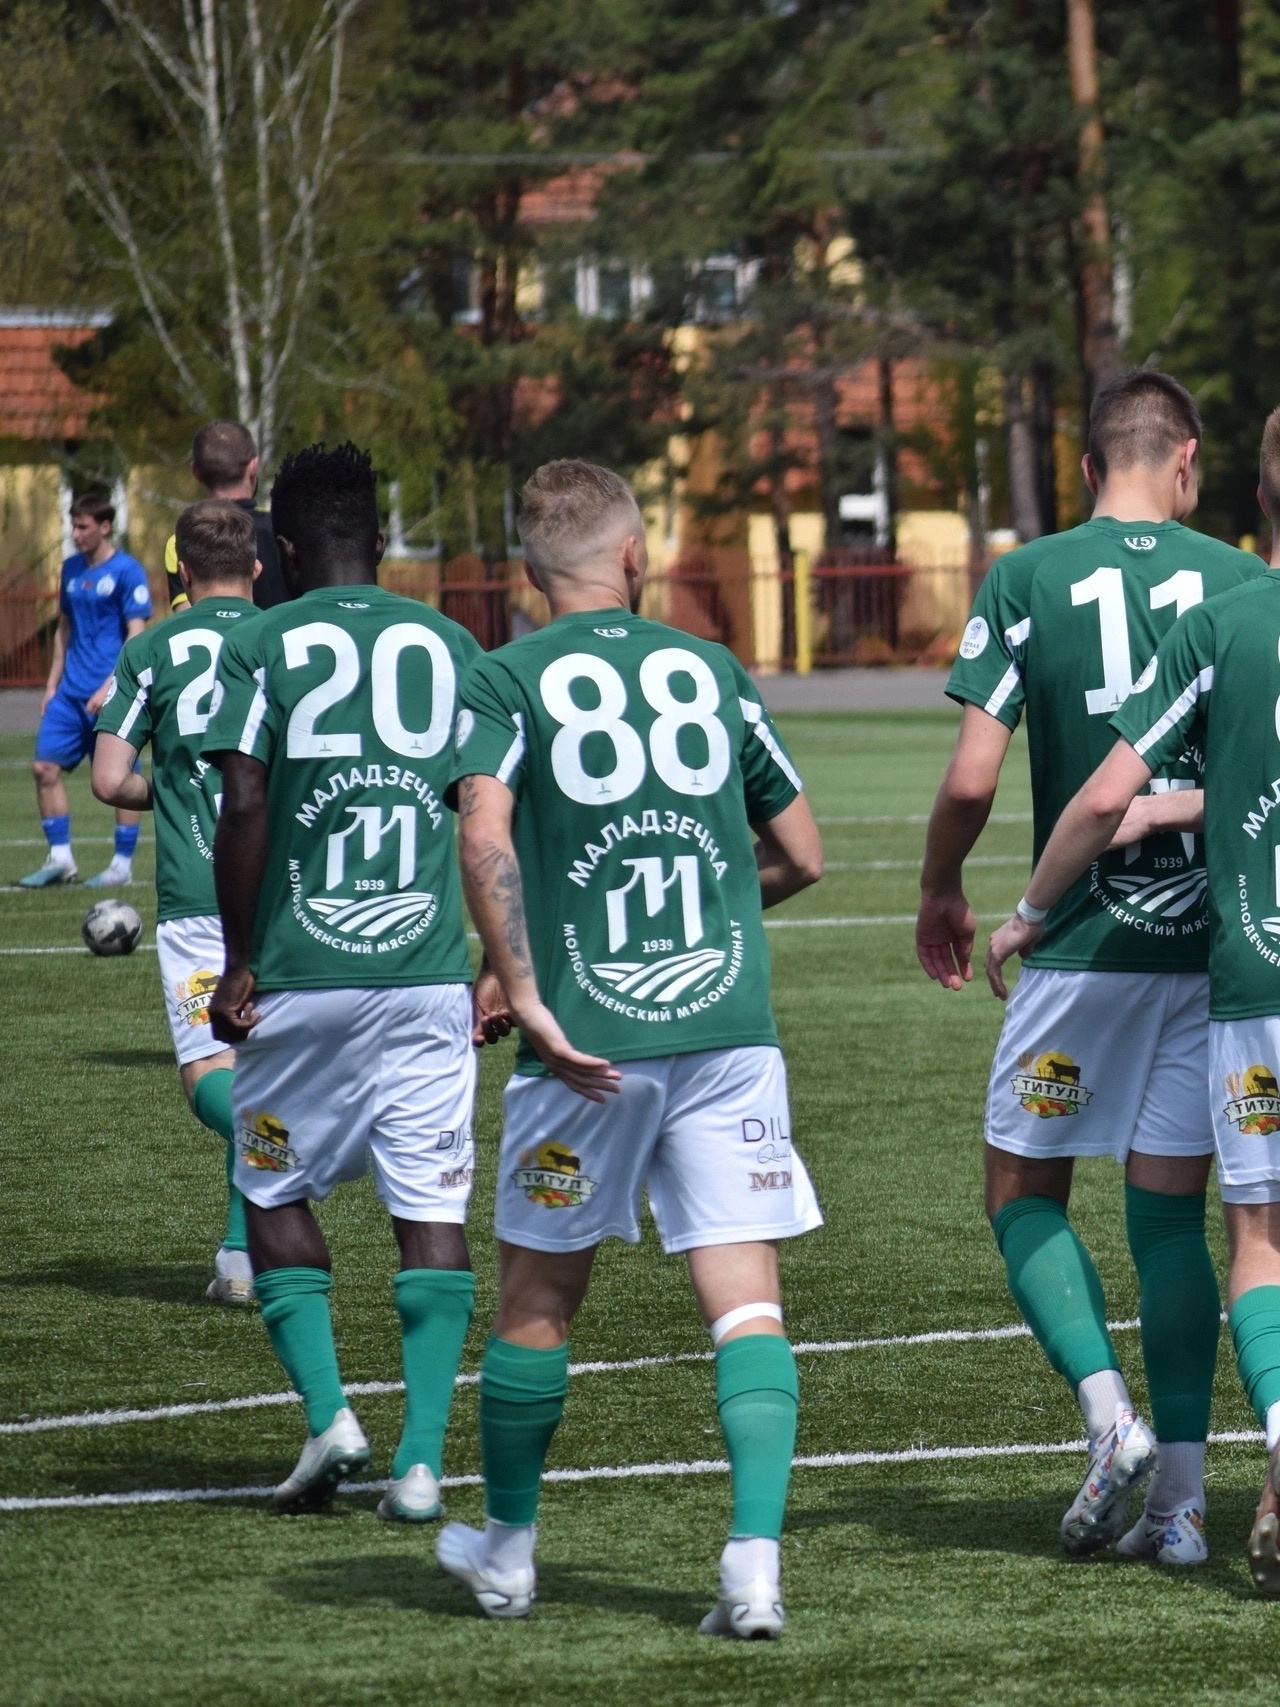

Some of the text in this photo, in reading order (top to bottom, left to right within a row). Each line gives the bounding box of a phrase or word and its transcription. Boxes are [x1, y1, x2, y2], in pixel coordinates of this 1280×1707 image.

[281, 622, 456, 759] 20
[539, 647, 731, 805] 88
[295, 764, 444, 830] МАЛАДЗЕЧНА
[567, 809, 729, 888] МАЛАДЗЕЧНА
[1153, 857, 1184, 869] 1939
[354, 880, 385, 891] 1939
[641, 938, 674, 953] 1939
[563, 919, 744, 1022] МОЛОДЕЧНЕНСКИЙ МЯСОКОМБИНАТ
[1022, 1078, 1080, 1100] ТИТУЛ
[245, 1131, 289, 1159] ТИТУЛ
[523, 1172, 582, 1192] ТИТУЛ
